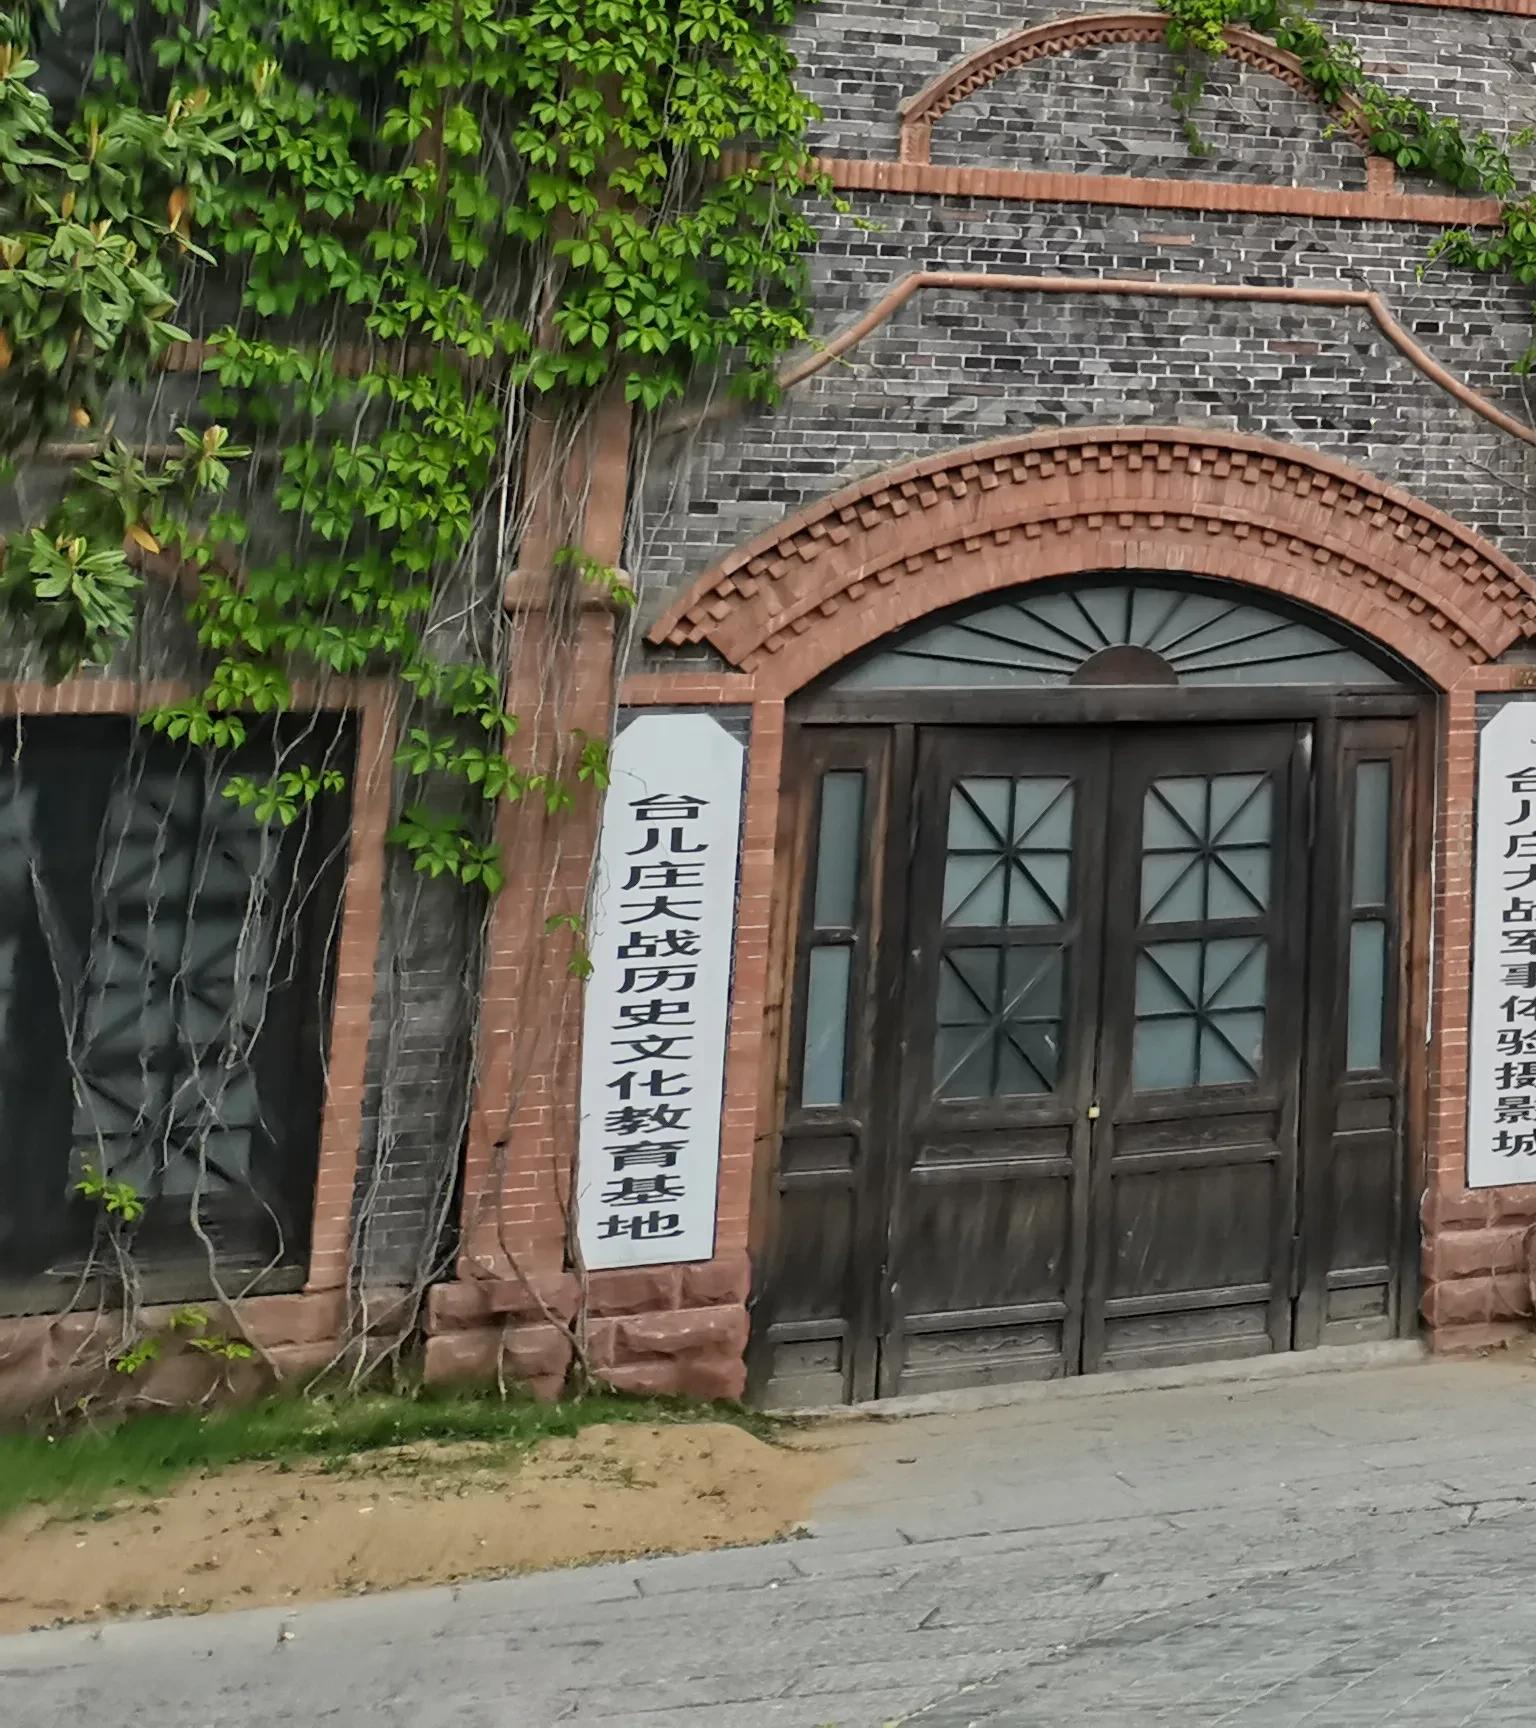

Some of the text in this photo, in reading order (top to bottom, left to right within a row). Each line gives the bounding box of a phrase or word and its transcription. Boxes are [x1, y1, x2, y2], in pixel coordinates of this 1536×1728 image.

[597, 792, 711, 1242] 台儿庄大战历史文化教育基地
